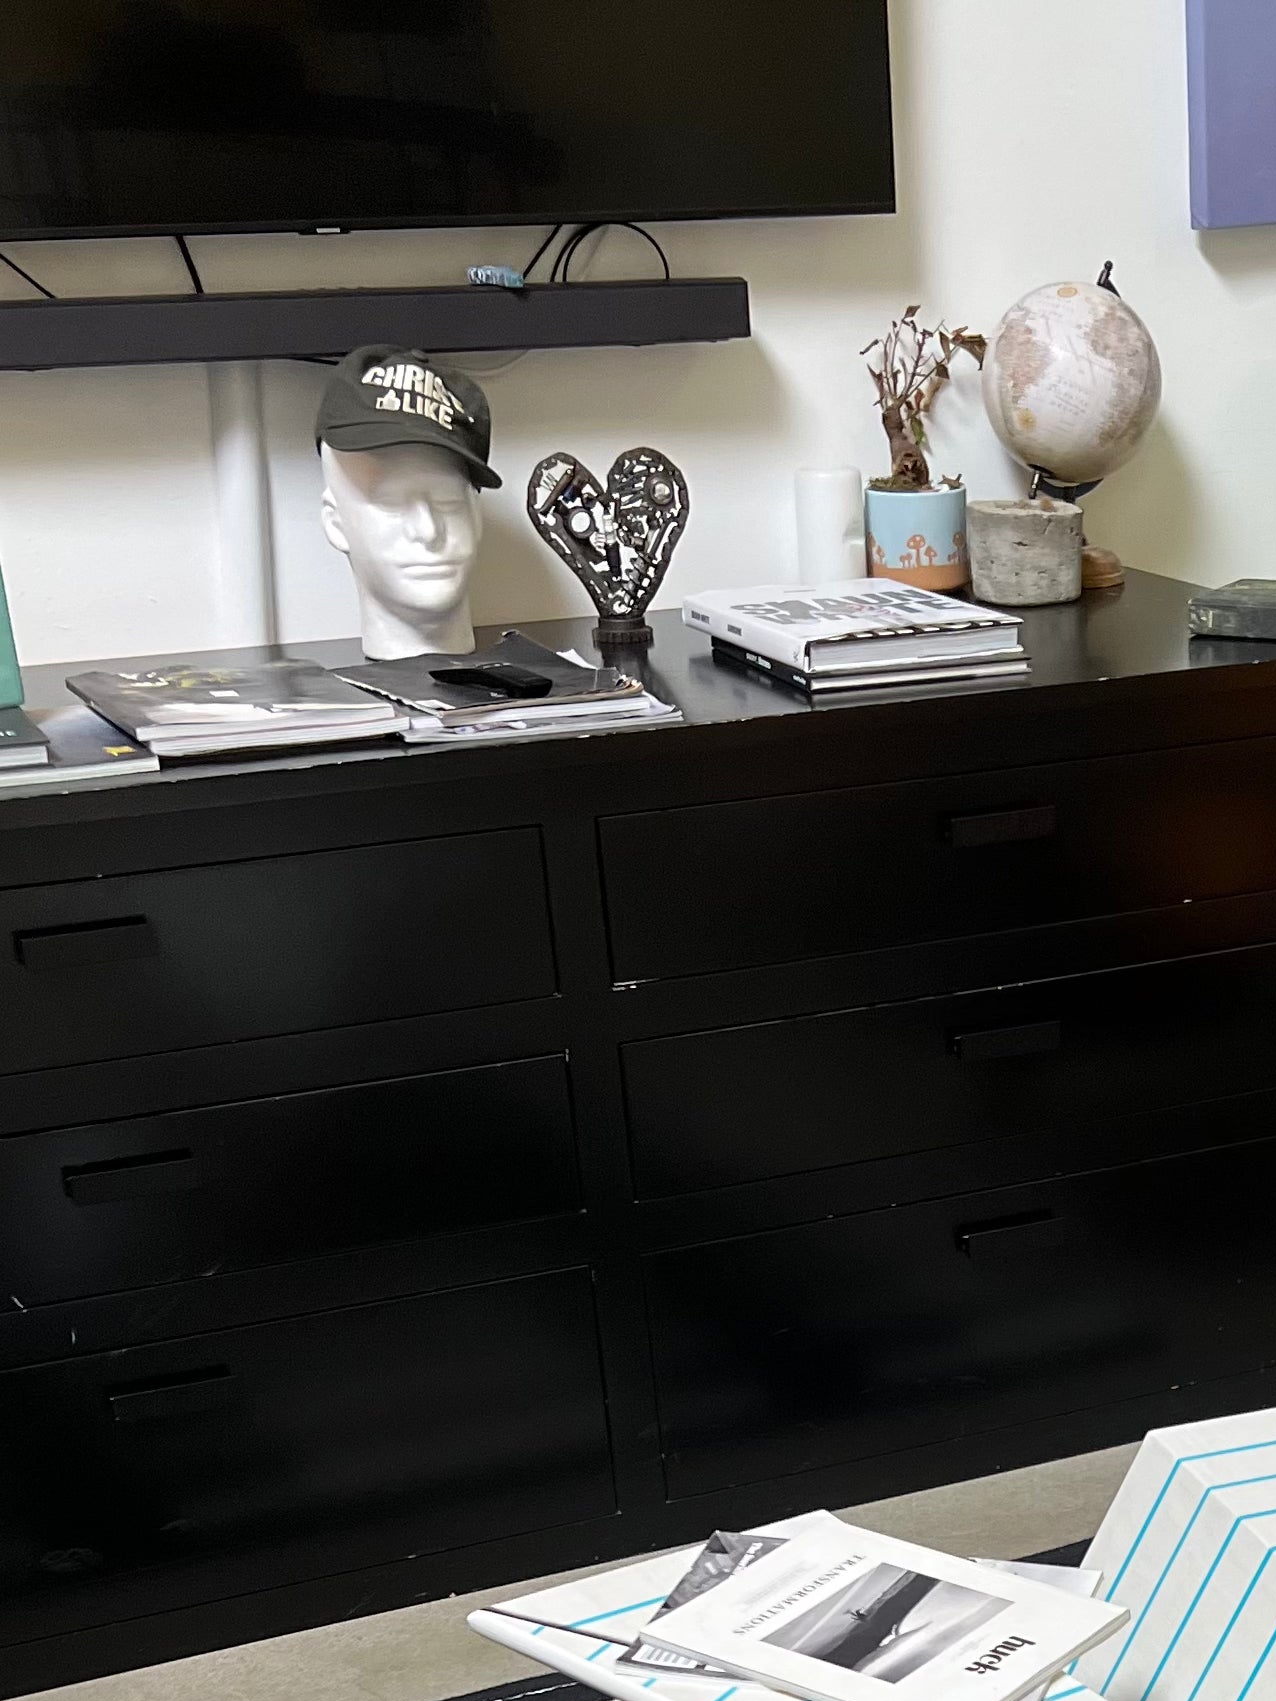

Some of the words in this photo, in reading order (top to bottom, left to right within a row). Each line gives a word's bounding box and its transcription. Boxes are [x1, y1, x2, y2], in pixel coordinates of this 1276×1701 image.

[402, 392, 454, 430] LIKE
[733, 1554, 866, 1635] TRANSFORMATIONS
[964, 1635, 1036, 1675] huck
